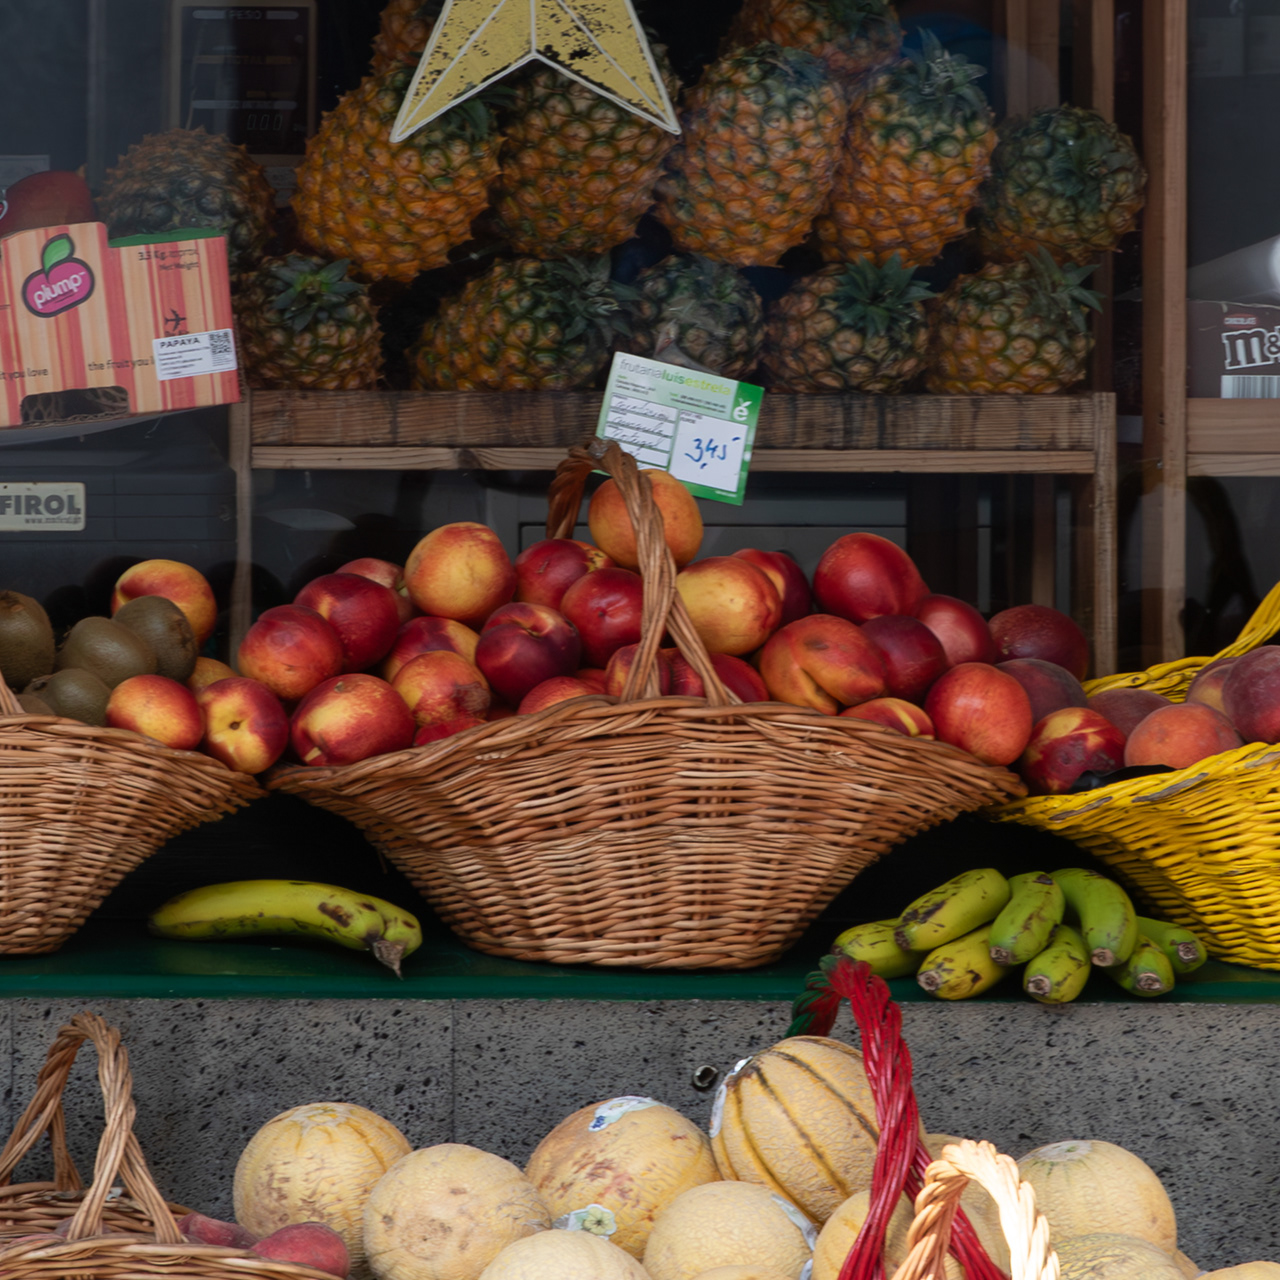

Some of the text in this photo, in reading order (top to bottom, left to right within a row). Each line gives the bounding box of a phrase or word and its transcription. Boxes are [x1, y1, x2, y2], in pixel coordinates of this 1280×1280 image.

[33, 273, 83, 309] plump
[160, 337, 201, 349] PAPAYA
[27, 367, 48, 376] love
[88, 361, 105, 371] the
